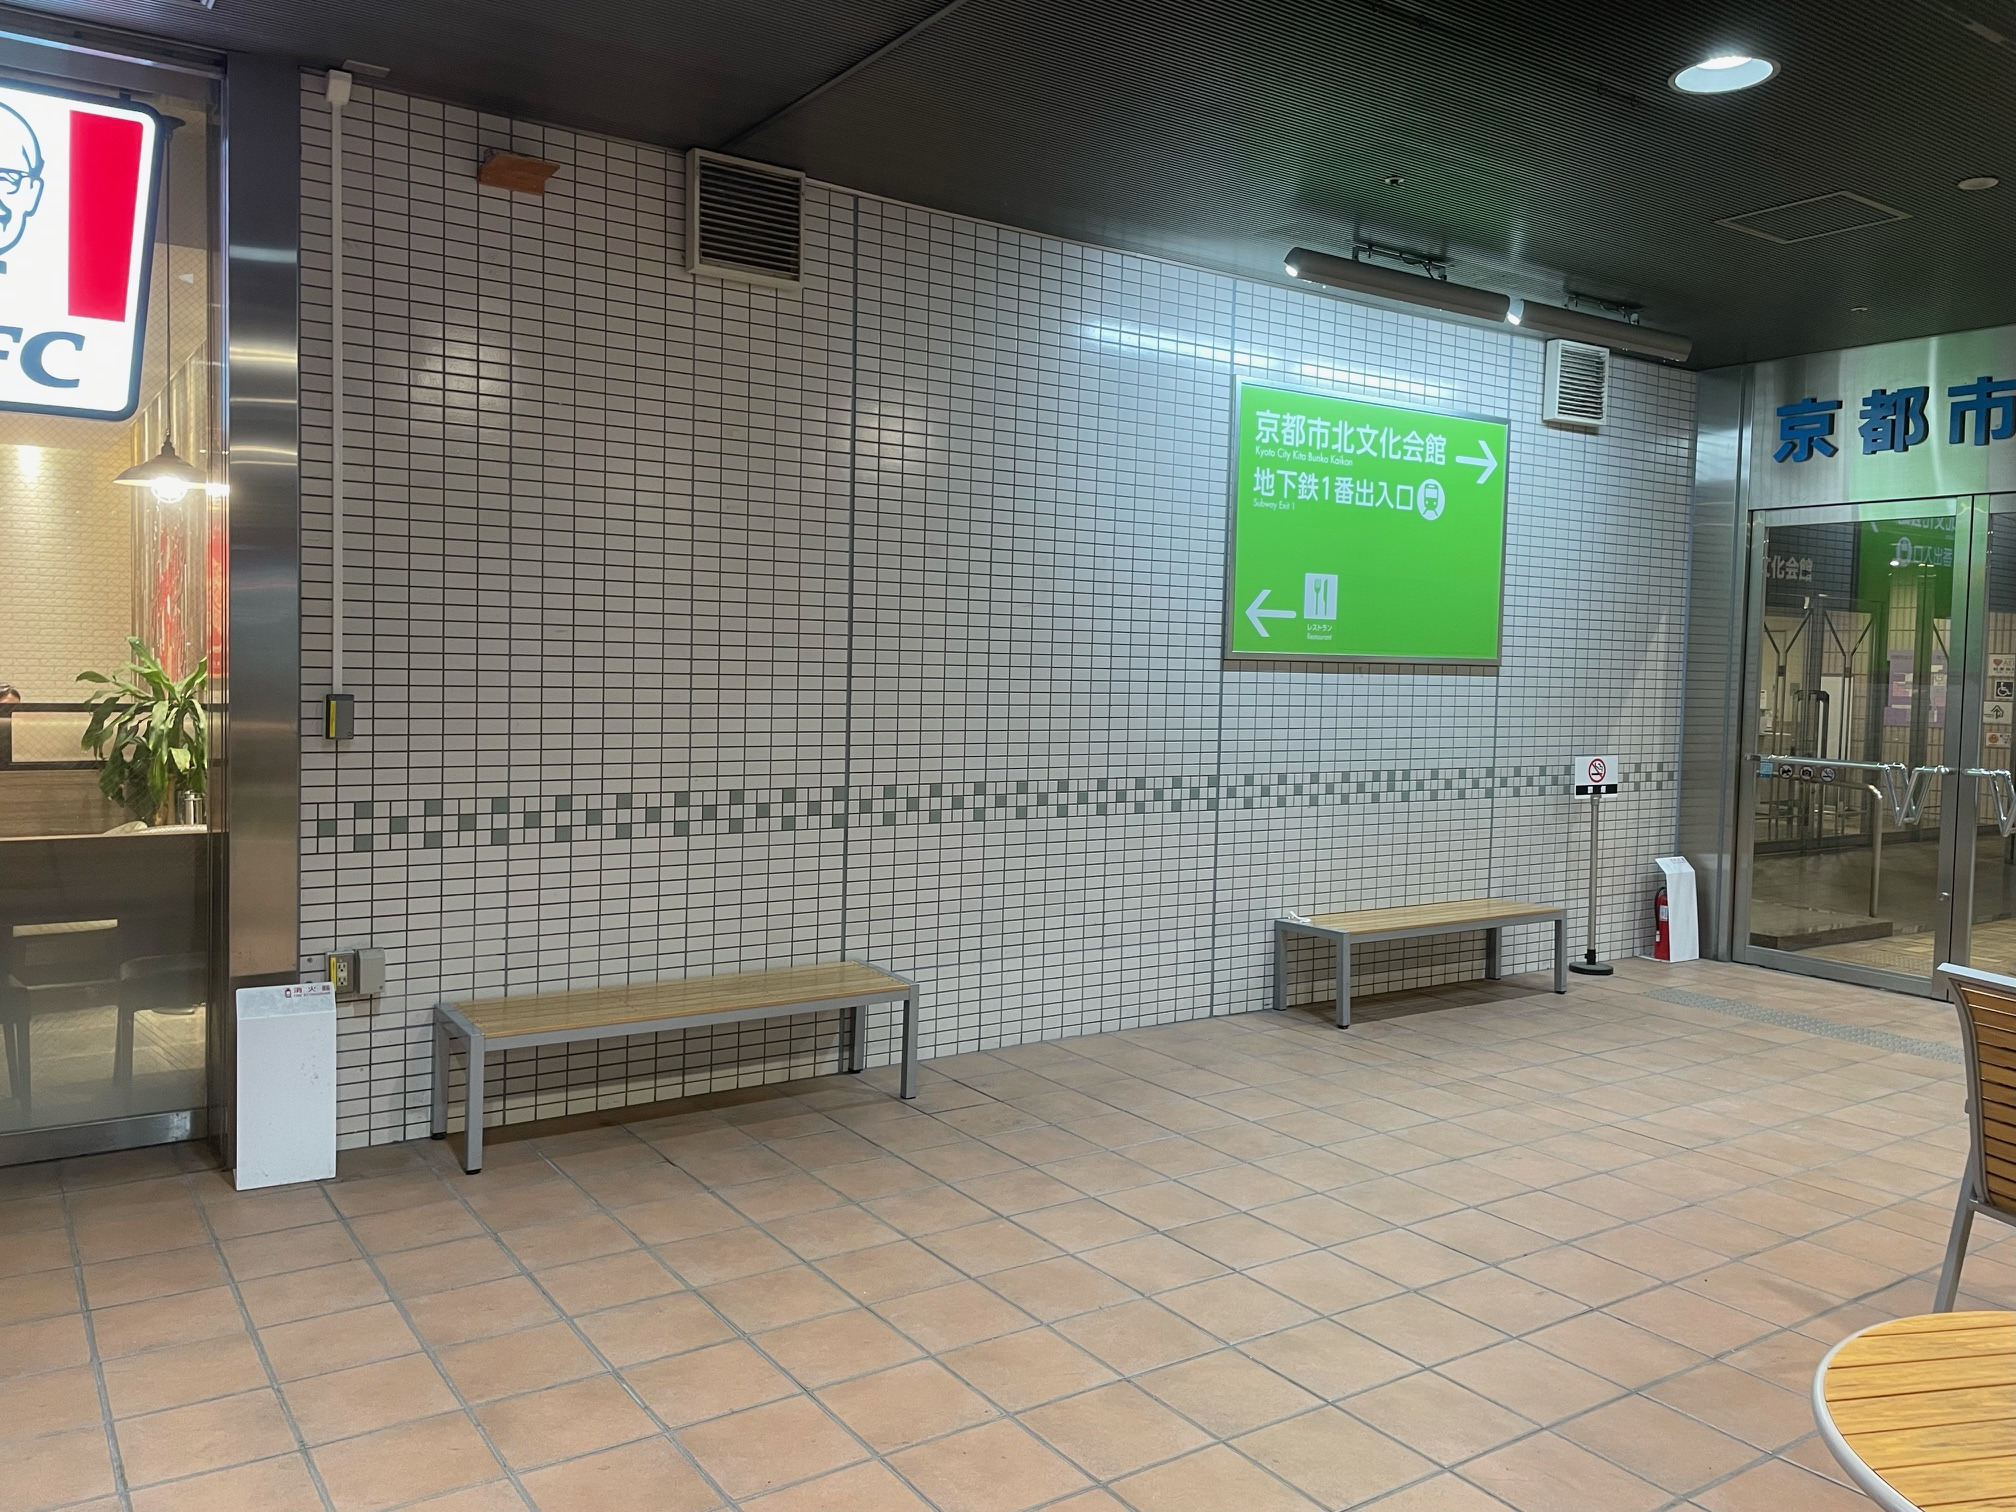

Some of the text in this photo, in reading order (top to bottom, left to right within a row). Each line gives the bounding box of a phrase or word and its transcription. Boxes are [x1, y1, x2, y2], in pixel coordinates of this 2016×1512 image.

[1773, 376, 2016, 463] 京都市
[1255, 409, 1447, 466] 京都市北文化会館
[1255, 446, 1354, 466] Kyoto City Kita Bunka Kaikan
[1253, 466, 1414, 511] 地下鉄1番出入口
[1253, 498, 1277, 511] Subway
[1279, 500, 1290, 510] Exit
[1307, 624, 1332, 632] レストラン
